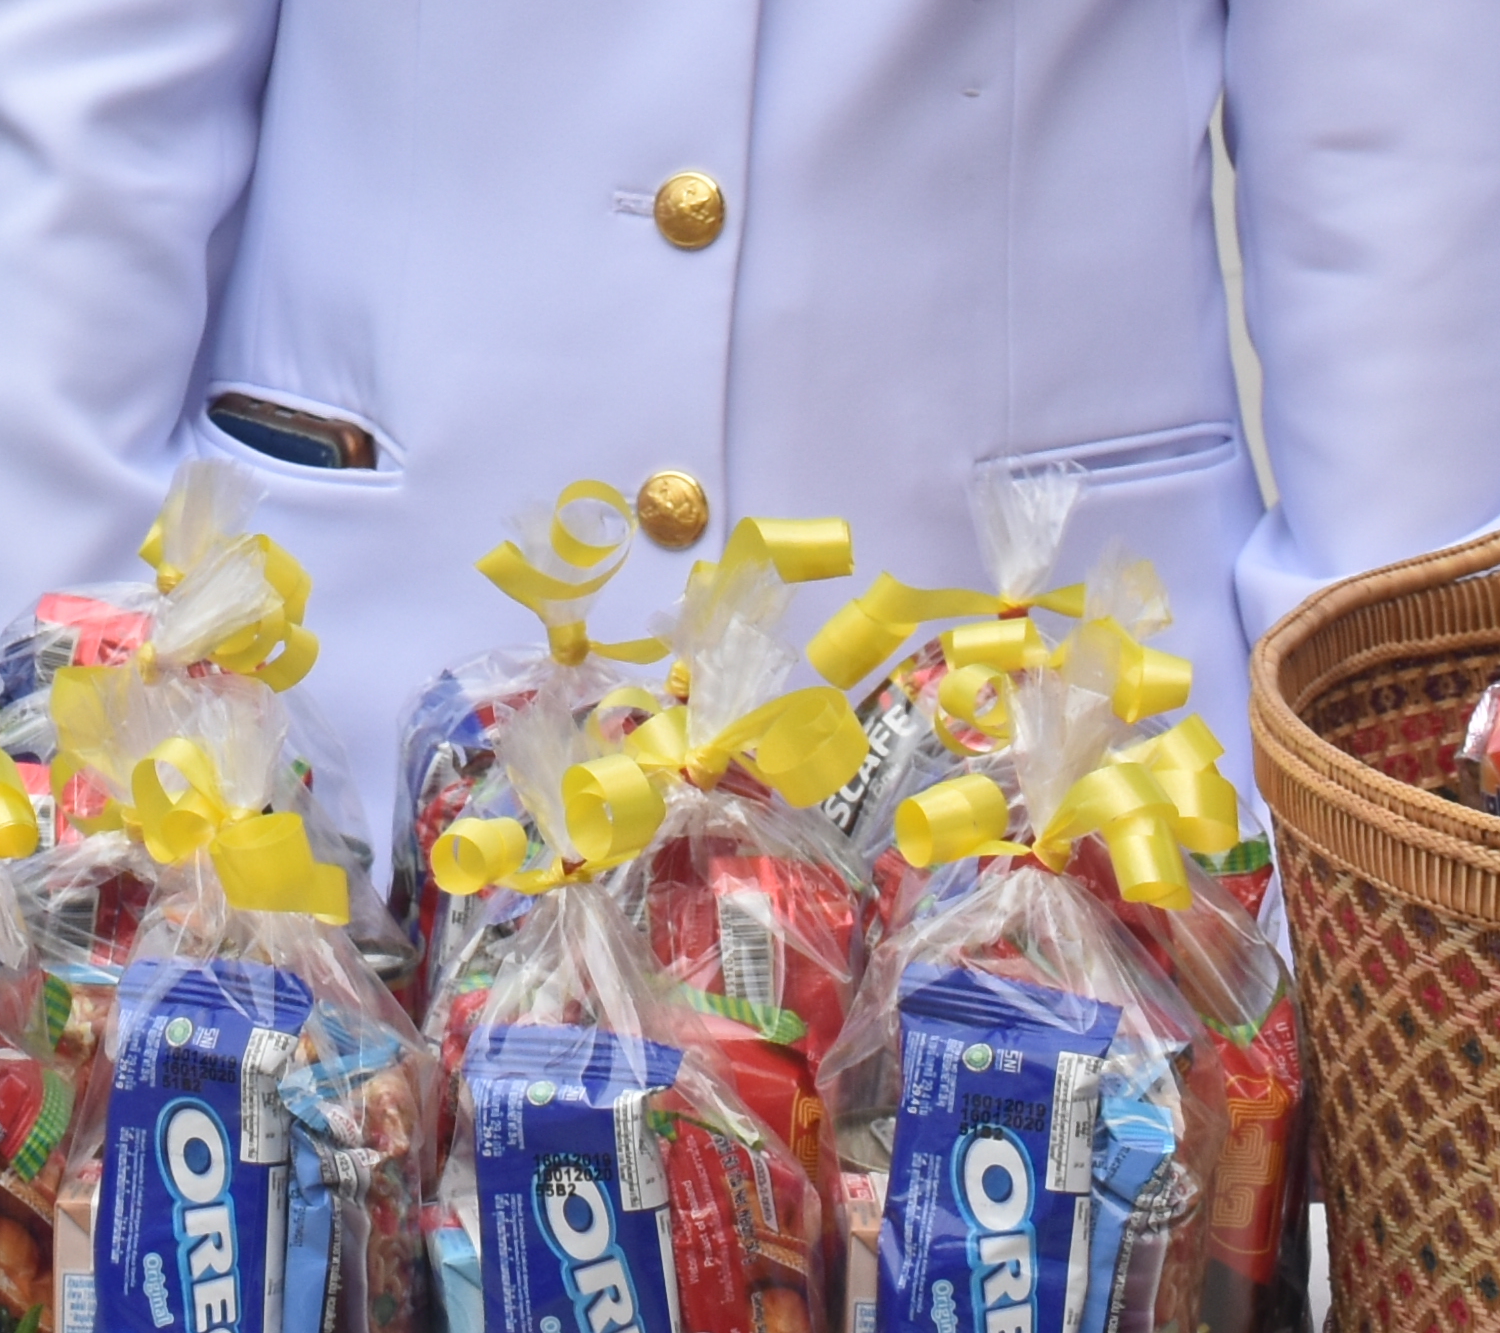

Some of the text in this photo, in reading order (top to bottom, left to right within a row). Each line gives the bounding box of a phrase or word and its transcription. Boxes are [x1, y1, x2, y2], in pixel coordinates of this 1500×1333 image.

[144, 1253, 174, 1327] Original
[165, 1107, 237, 1333] ORE
[544, 1164, 640, 1333] OR
[963, 1134, 1033, 1333] ORE
[932, 1280, 957, 1333] Origin
